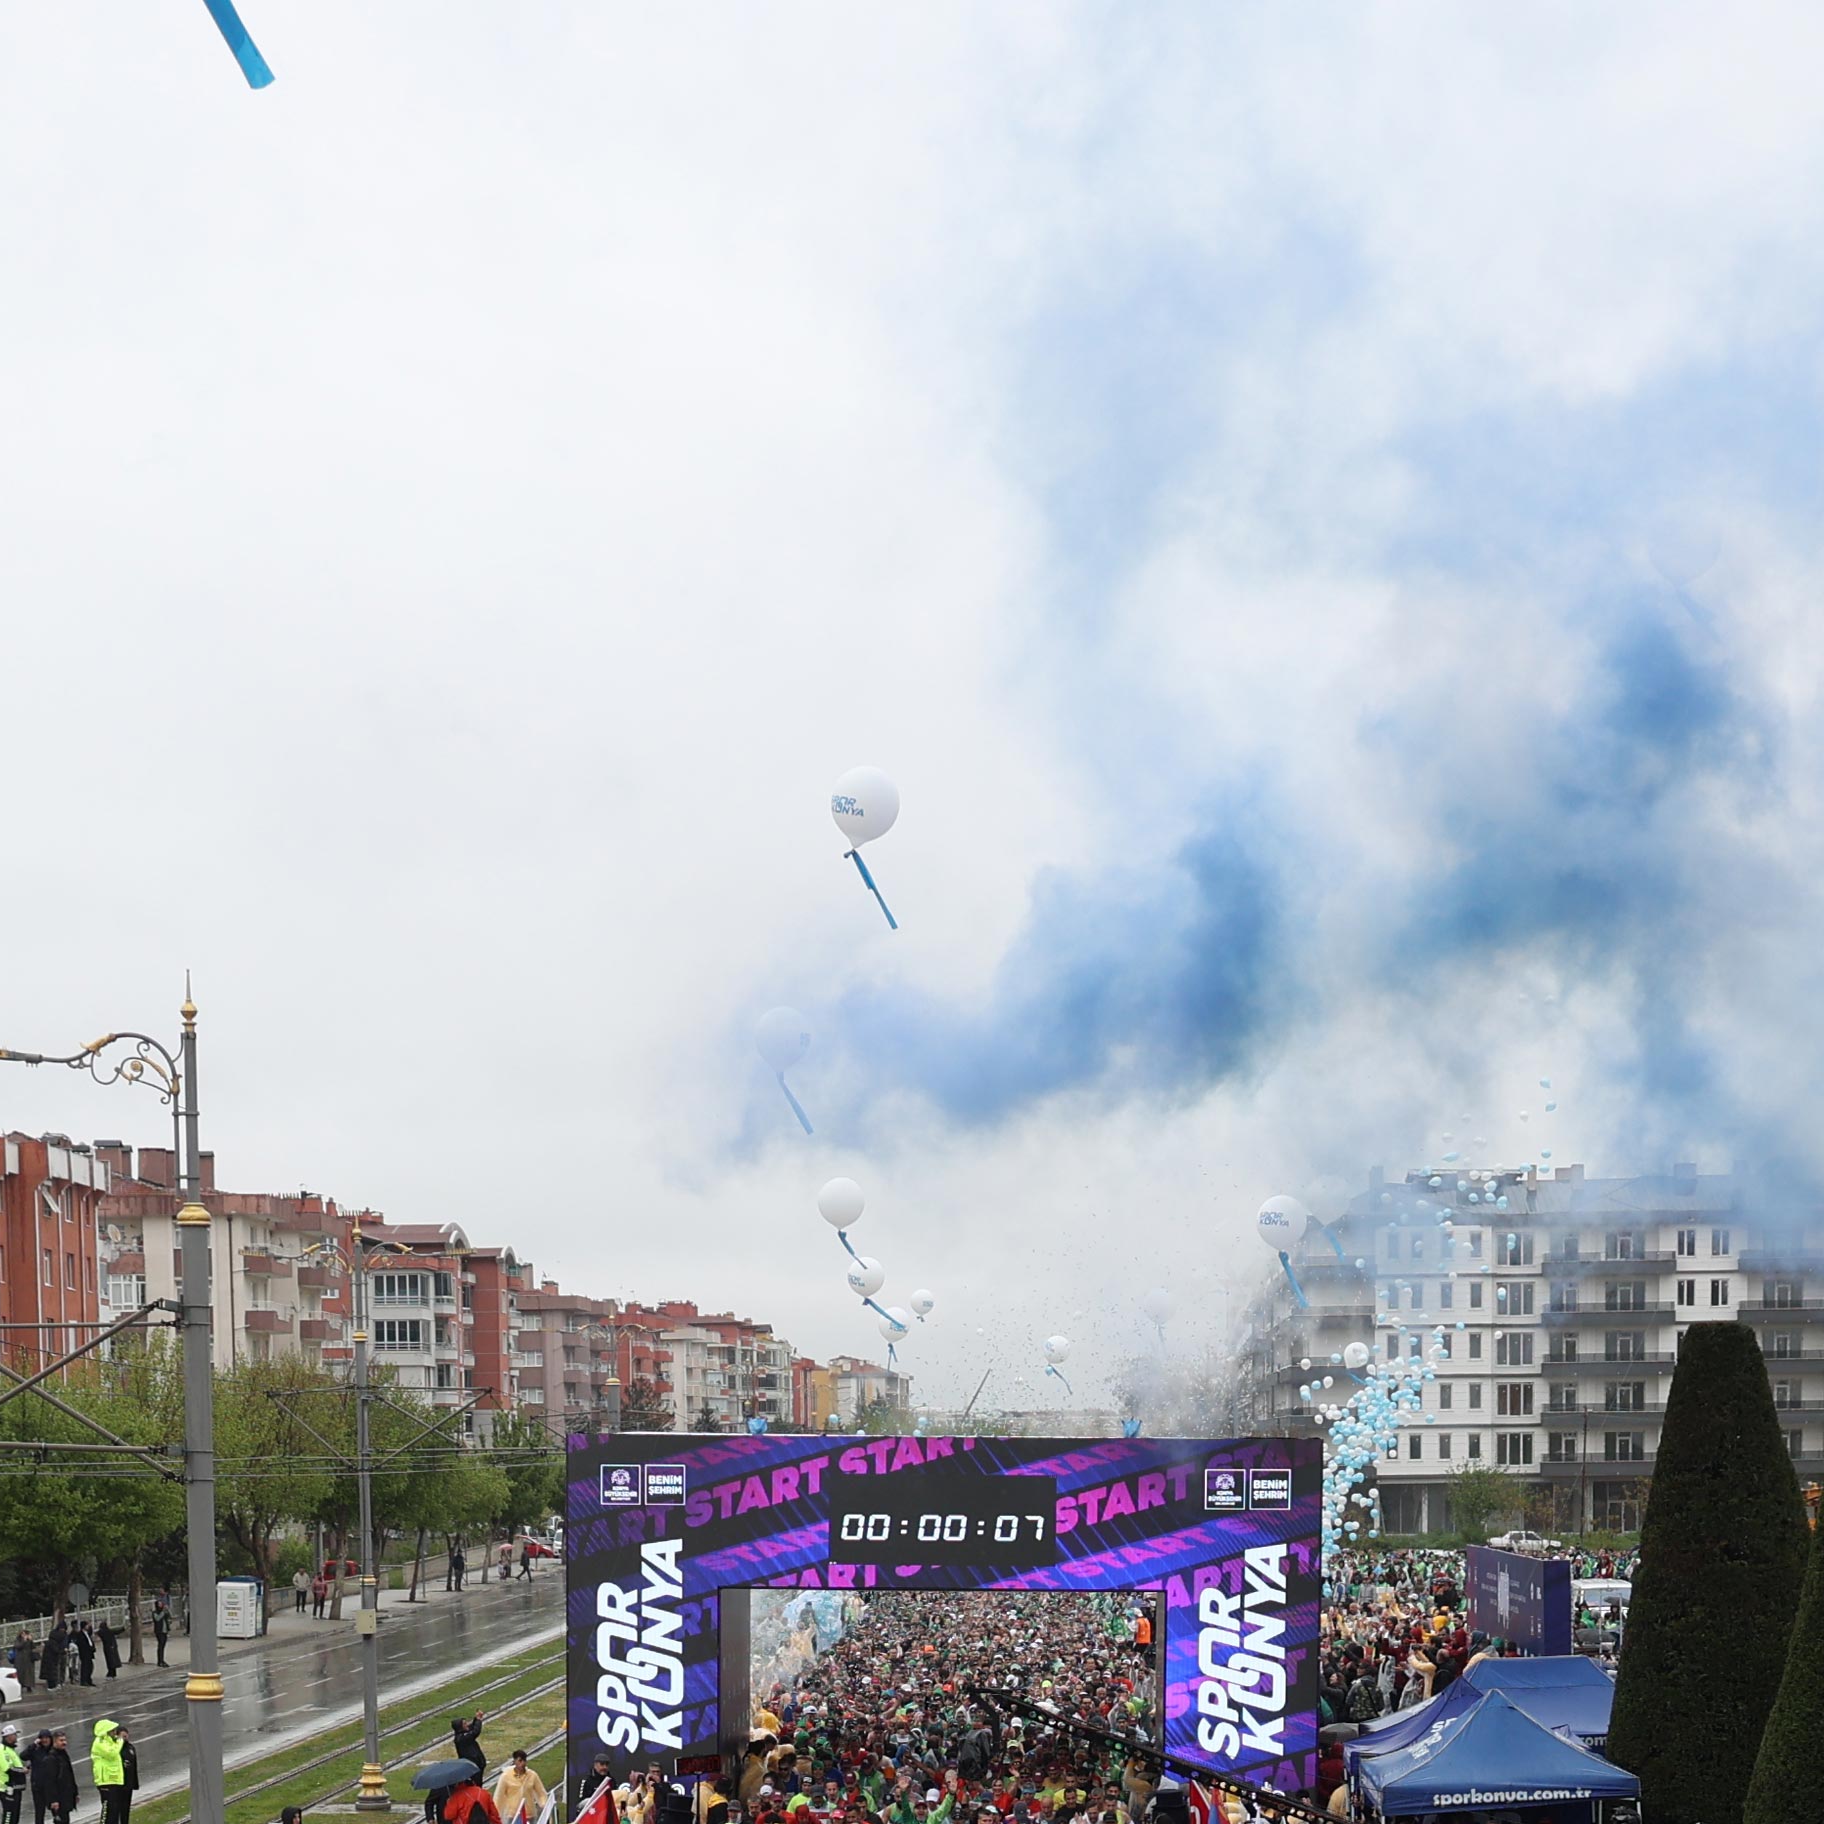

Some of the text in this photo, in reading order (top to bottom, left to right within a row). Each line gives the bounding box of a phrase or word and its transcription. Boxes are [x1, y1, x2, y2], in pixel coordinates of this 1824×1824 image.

[684, 1454, 831, 1529] START
[840, 1513, 1046, 1542] 00:00:07
[596, 1581, 640, 1754] SPOR
[626, 1538, 685, 1750] KONYA
[1197, 1587, 1241, 1760] SPOR
[1227, 1543, 1287, 1756] KONYA
[1433, 1788, 1592, 1808] sporkonya.com.tr
